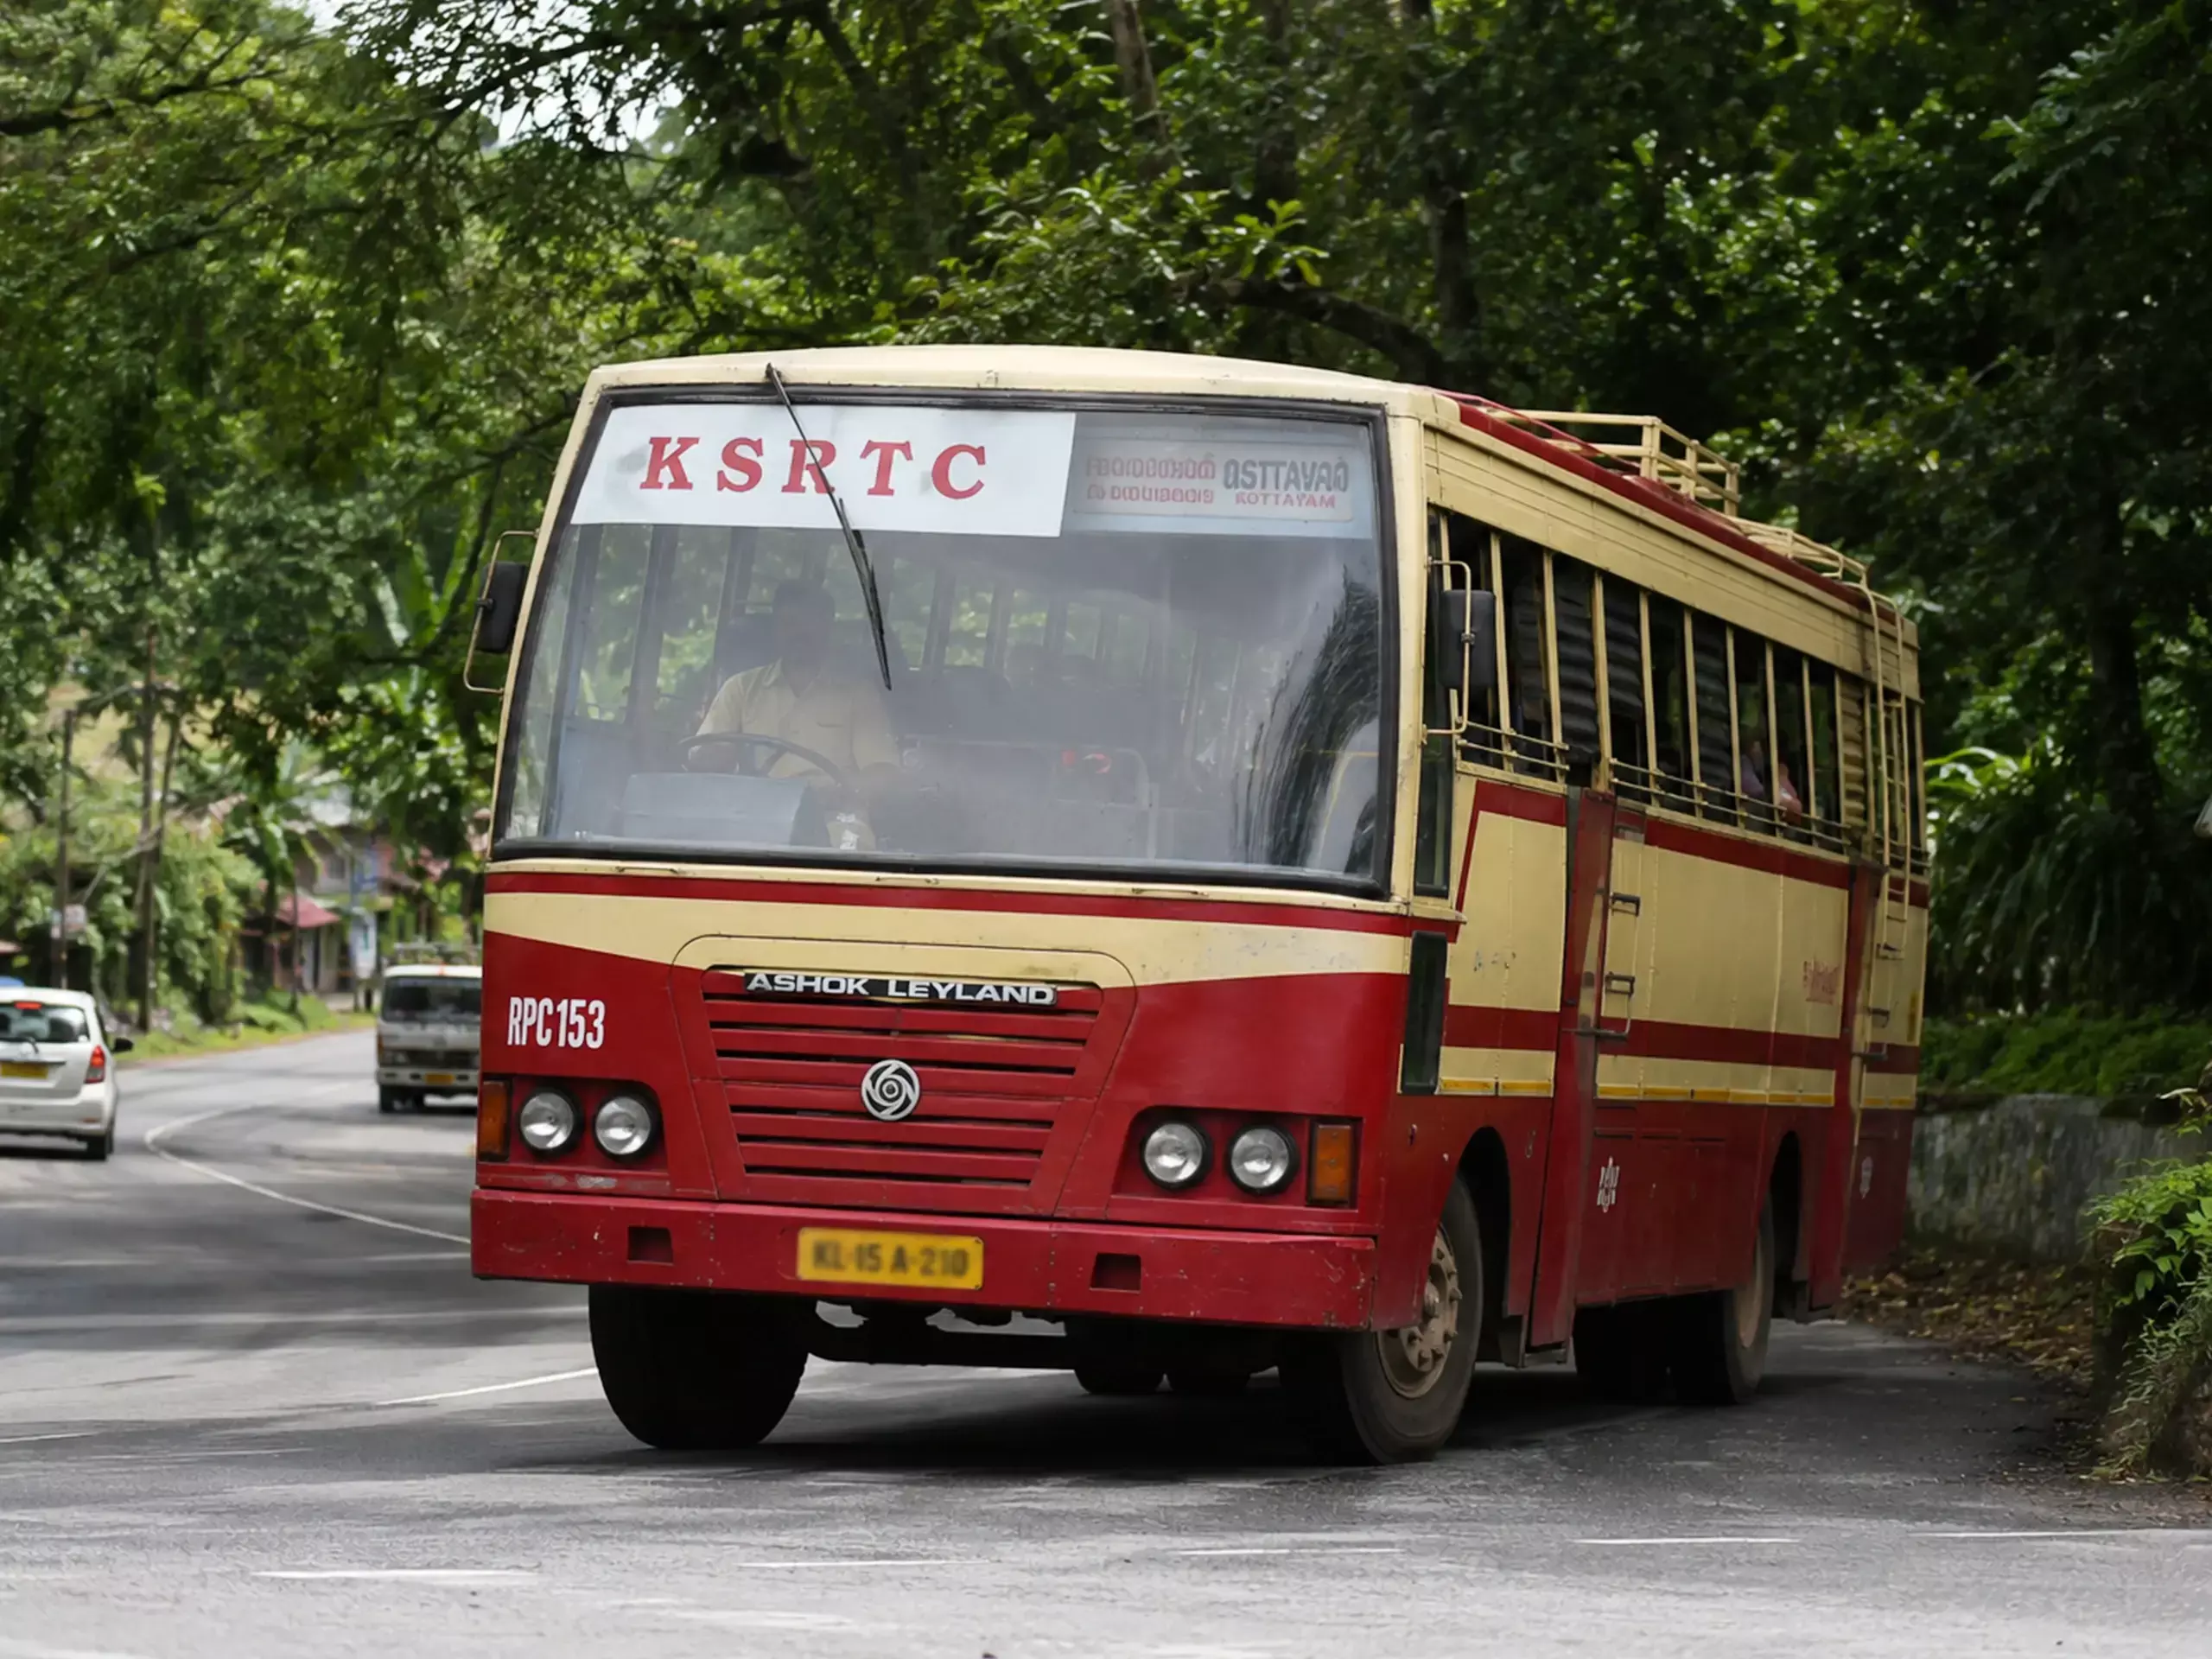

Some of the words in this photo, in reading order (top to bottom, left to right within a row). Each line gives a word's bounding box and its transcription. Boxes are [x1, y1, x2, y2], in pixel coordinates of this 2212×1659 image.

[1235, 492, 1336, 508] KOTTAYAM
[746, 973, 869, 995] ASHOK
[887, 979, 1056, 1005] LEYLAND
